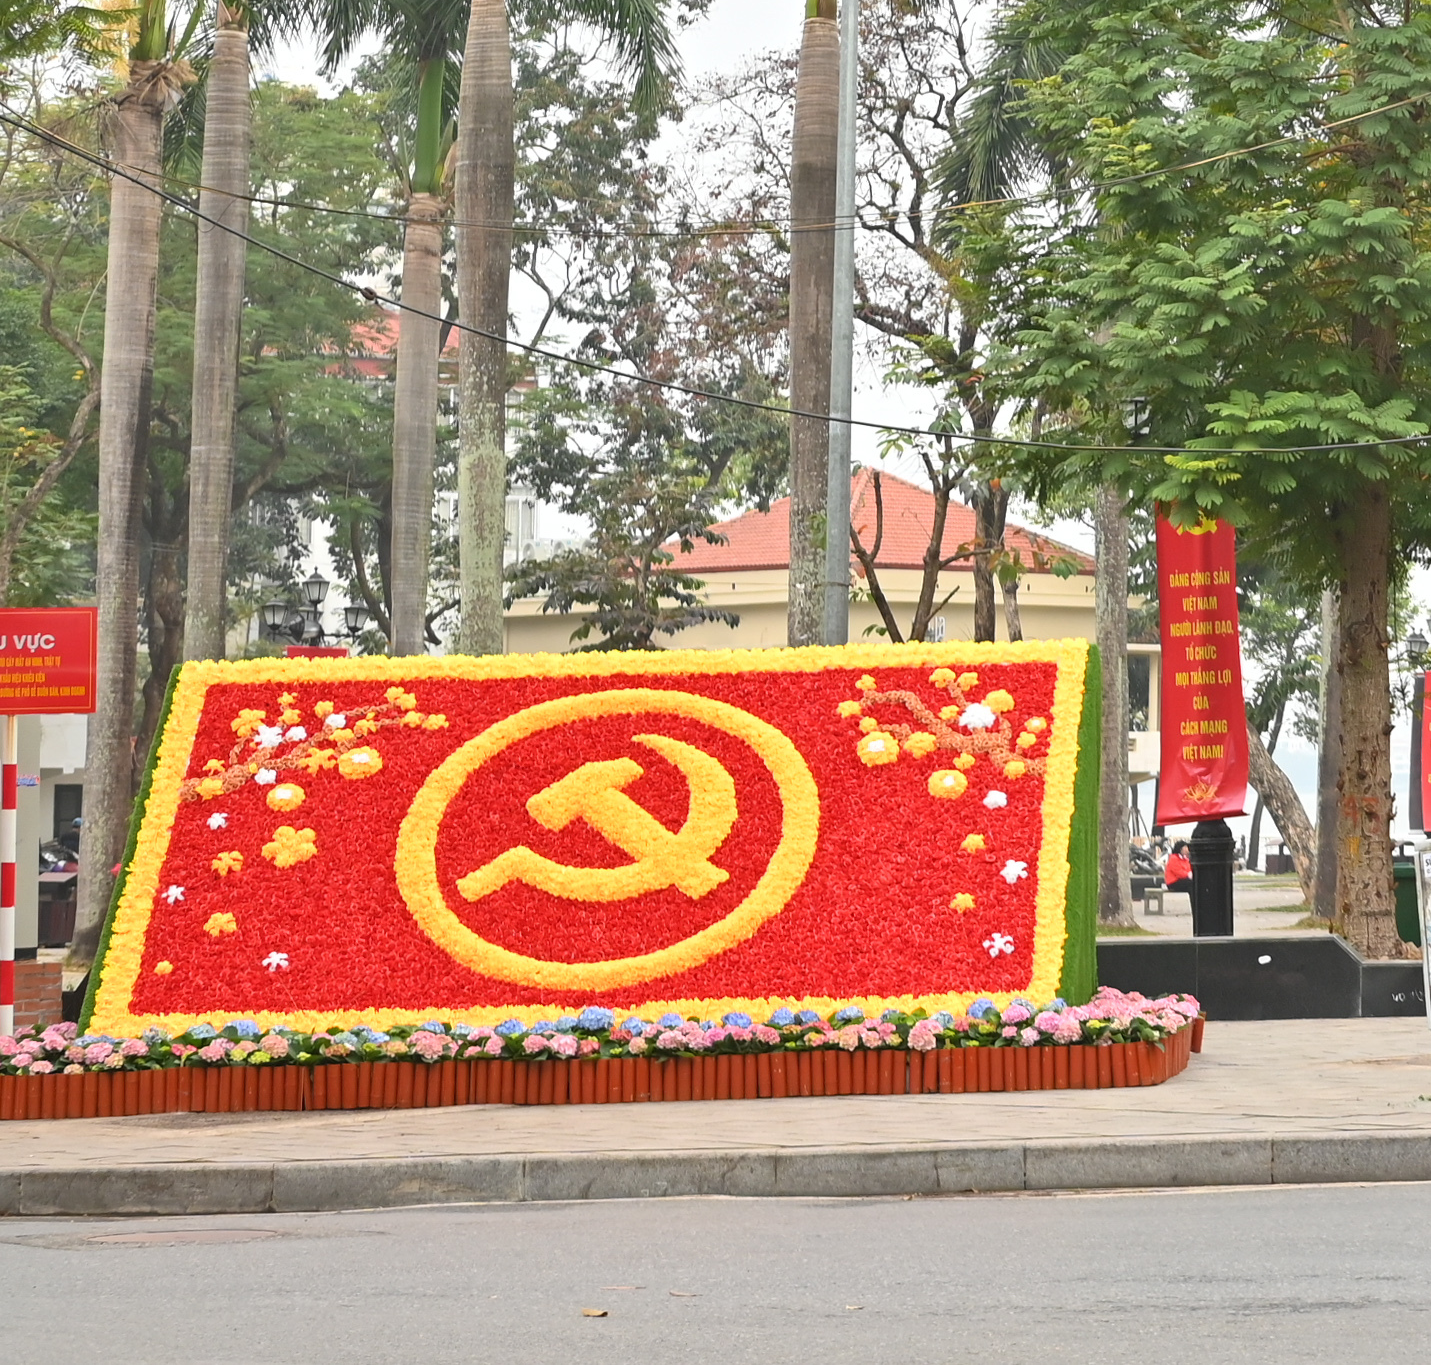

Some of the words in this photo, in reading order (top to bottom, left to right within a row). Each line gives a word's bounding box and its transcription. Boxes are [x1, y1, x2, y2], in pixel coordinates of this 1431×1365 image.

[1213, 566, 1231, 585] SẢN
[1182, 594, 1197, 614] VIỆT
[1197, 596, 1218, 610] NAM
[13, 632, 56, 653] VỰC
[1193, 691, 1210, 710] CỦA
[1200, 719, 1228, 737] MẠNG
[1183, 742, 1198, 763] VIỆT
